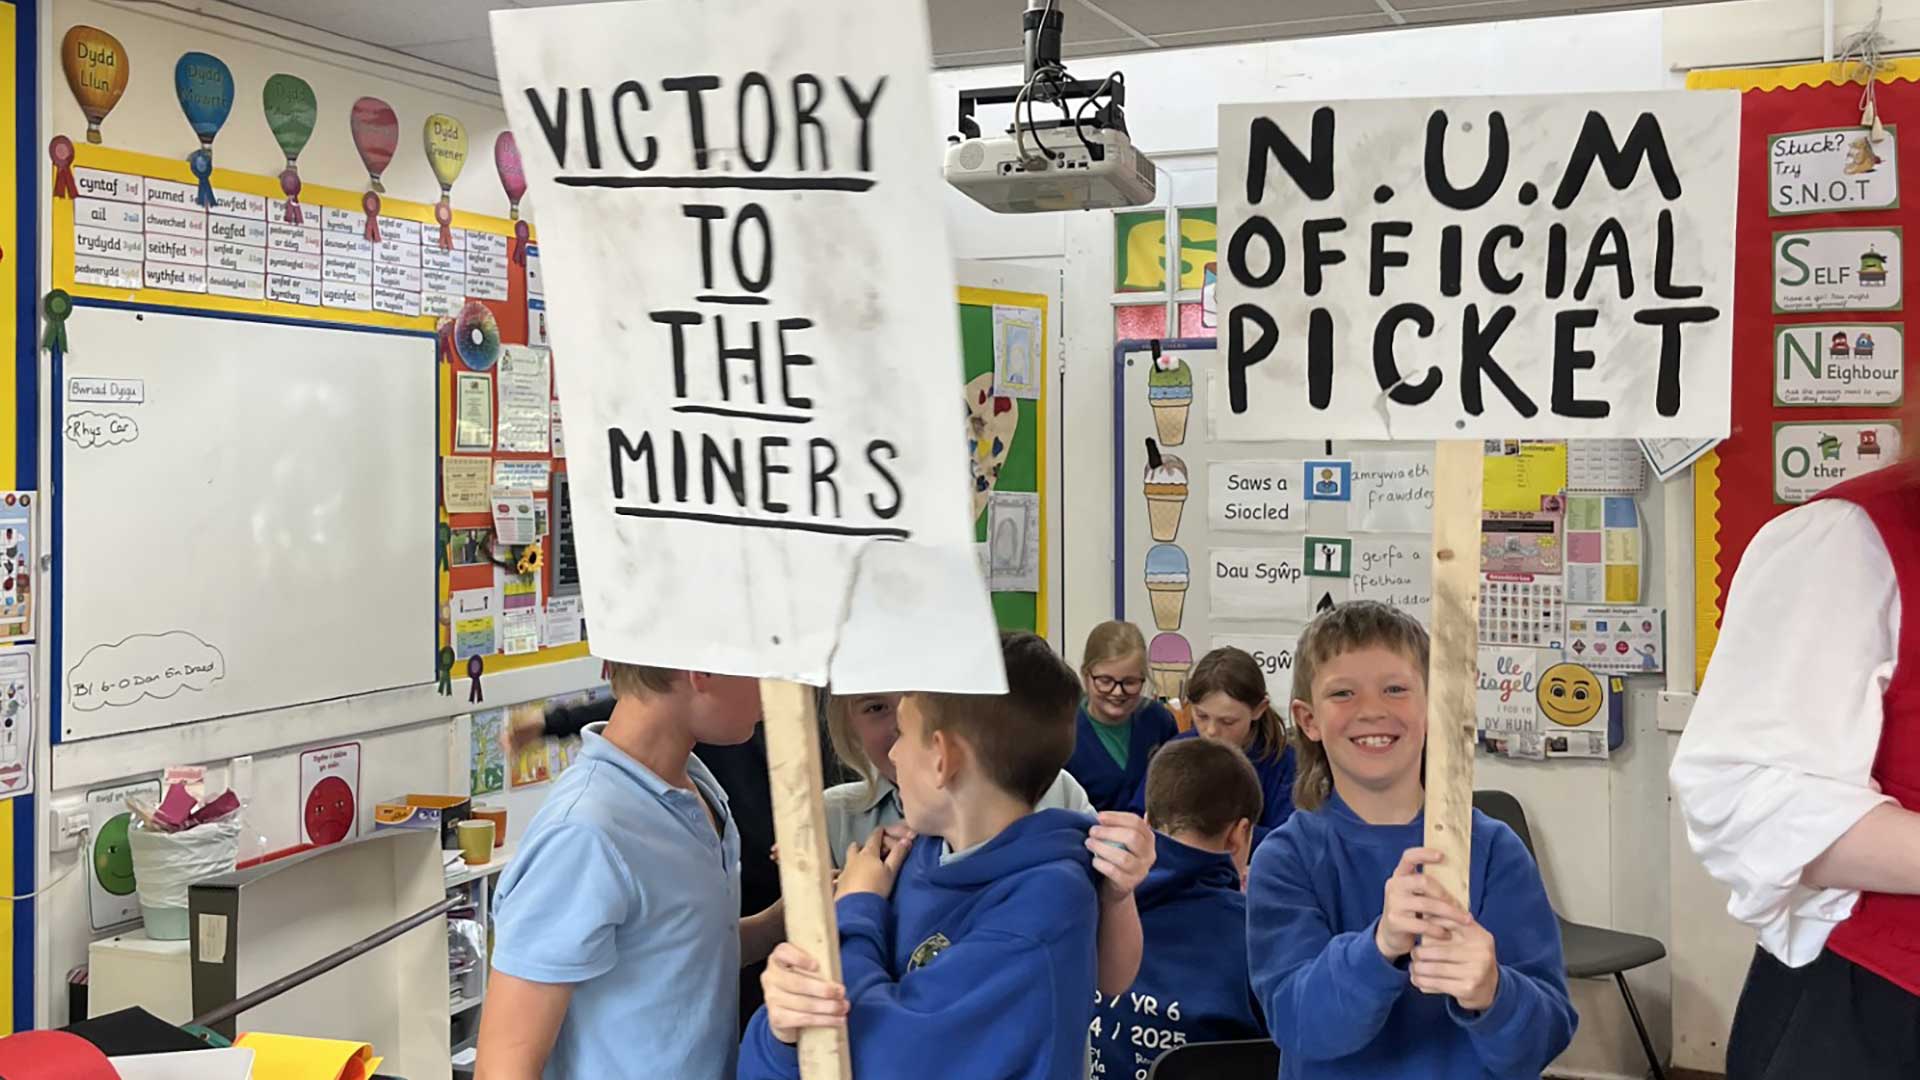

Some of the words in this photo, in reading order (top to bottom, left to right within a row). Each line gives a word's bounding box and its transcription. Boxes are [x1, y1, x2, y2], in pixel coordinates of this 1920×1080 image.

[77, 42, 115, 67] Dydd
[80, 70, 109, 92] Llun
[434, 122, 458, 141] Dydd
[524, 71, 888, 174] VICTORY
[1774, 134, 1845, 157] Stuck?
[1246, 107, 1682, 210] N.U.M
[1775, 160, 1801, 179] Try
[79, 178, 118, 196] cyntaf
[147, 188, 184, 203] pumed
[1779, 179, 1871, 206] S.N.O.T
[91, 207, 106, 221] ail
[215, 197, 247, 212] awfed
[211, 222, 245, 239] degfed
[78, 234, 121, 252] trydydd
[148, 241, 186, 258] seithfed
[682, 202, 775, 294] TO
[1227, 209, 1703, 300] OFFICIAL
[146, 268, 185, 284] wythfed
[648, 311, 815, 410] THE
[1228, 303, 1720, 419] PICKET
[72, 421, 102, 442] Rhys
[607, 427, 902, 520] MINERS
[1227, 475, 1271, 491] Saws
[1277, 482, 1288, 491] a
[1351, 463, 1429, 488] amrywiaeth
[1224, 504, 1289, 521] Siocled
[1412, 552, 1421, 560] a
[1216, 562, 1249, 579] Dau
[1255, 562, 1302, 584] Sgŵp
[1252, 650, 1293, 675] Sgŵ
[1496, 655, 1523, 676] lle
[1131, 992, 1158, 1016] YR
[1166, 1001, 1181, 1022] 6
[1131, 1025, 1188, 1050] 2025
